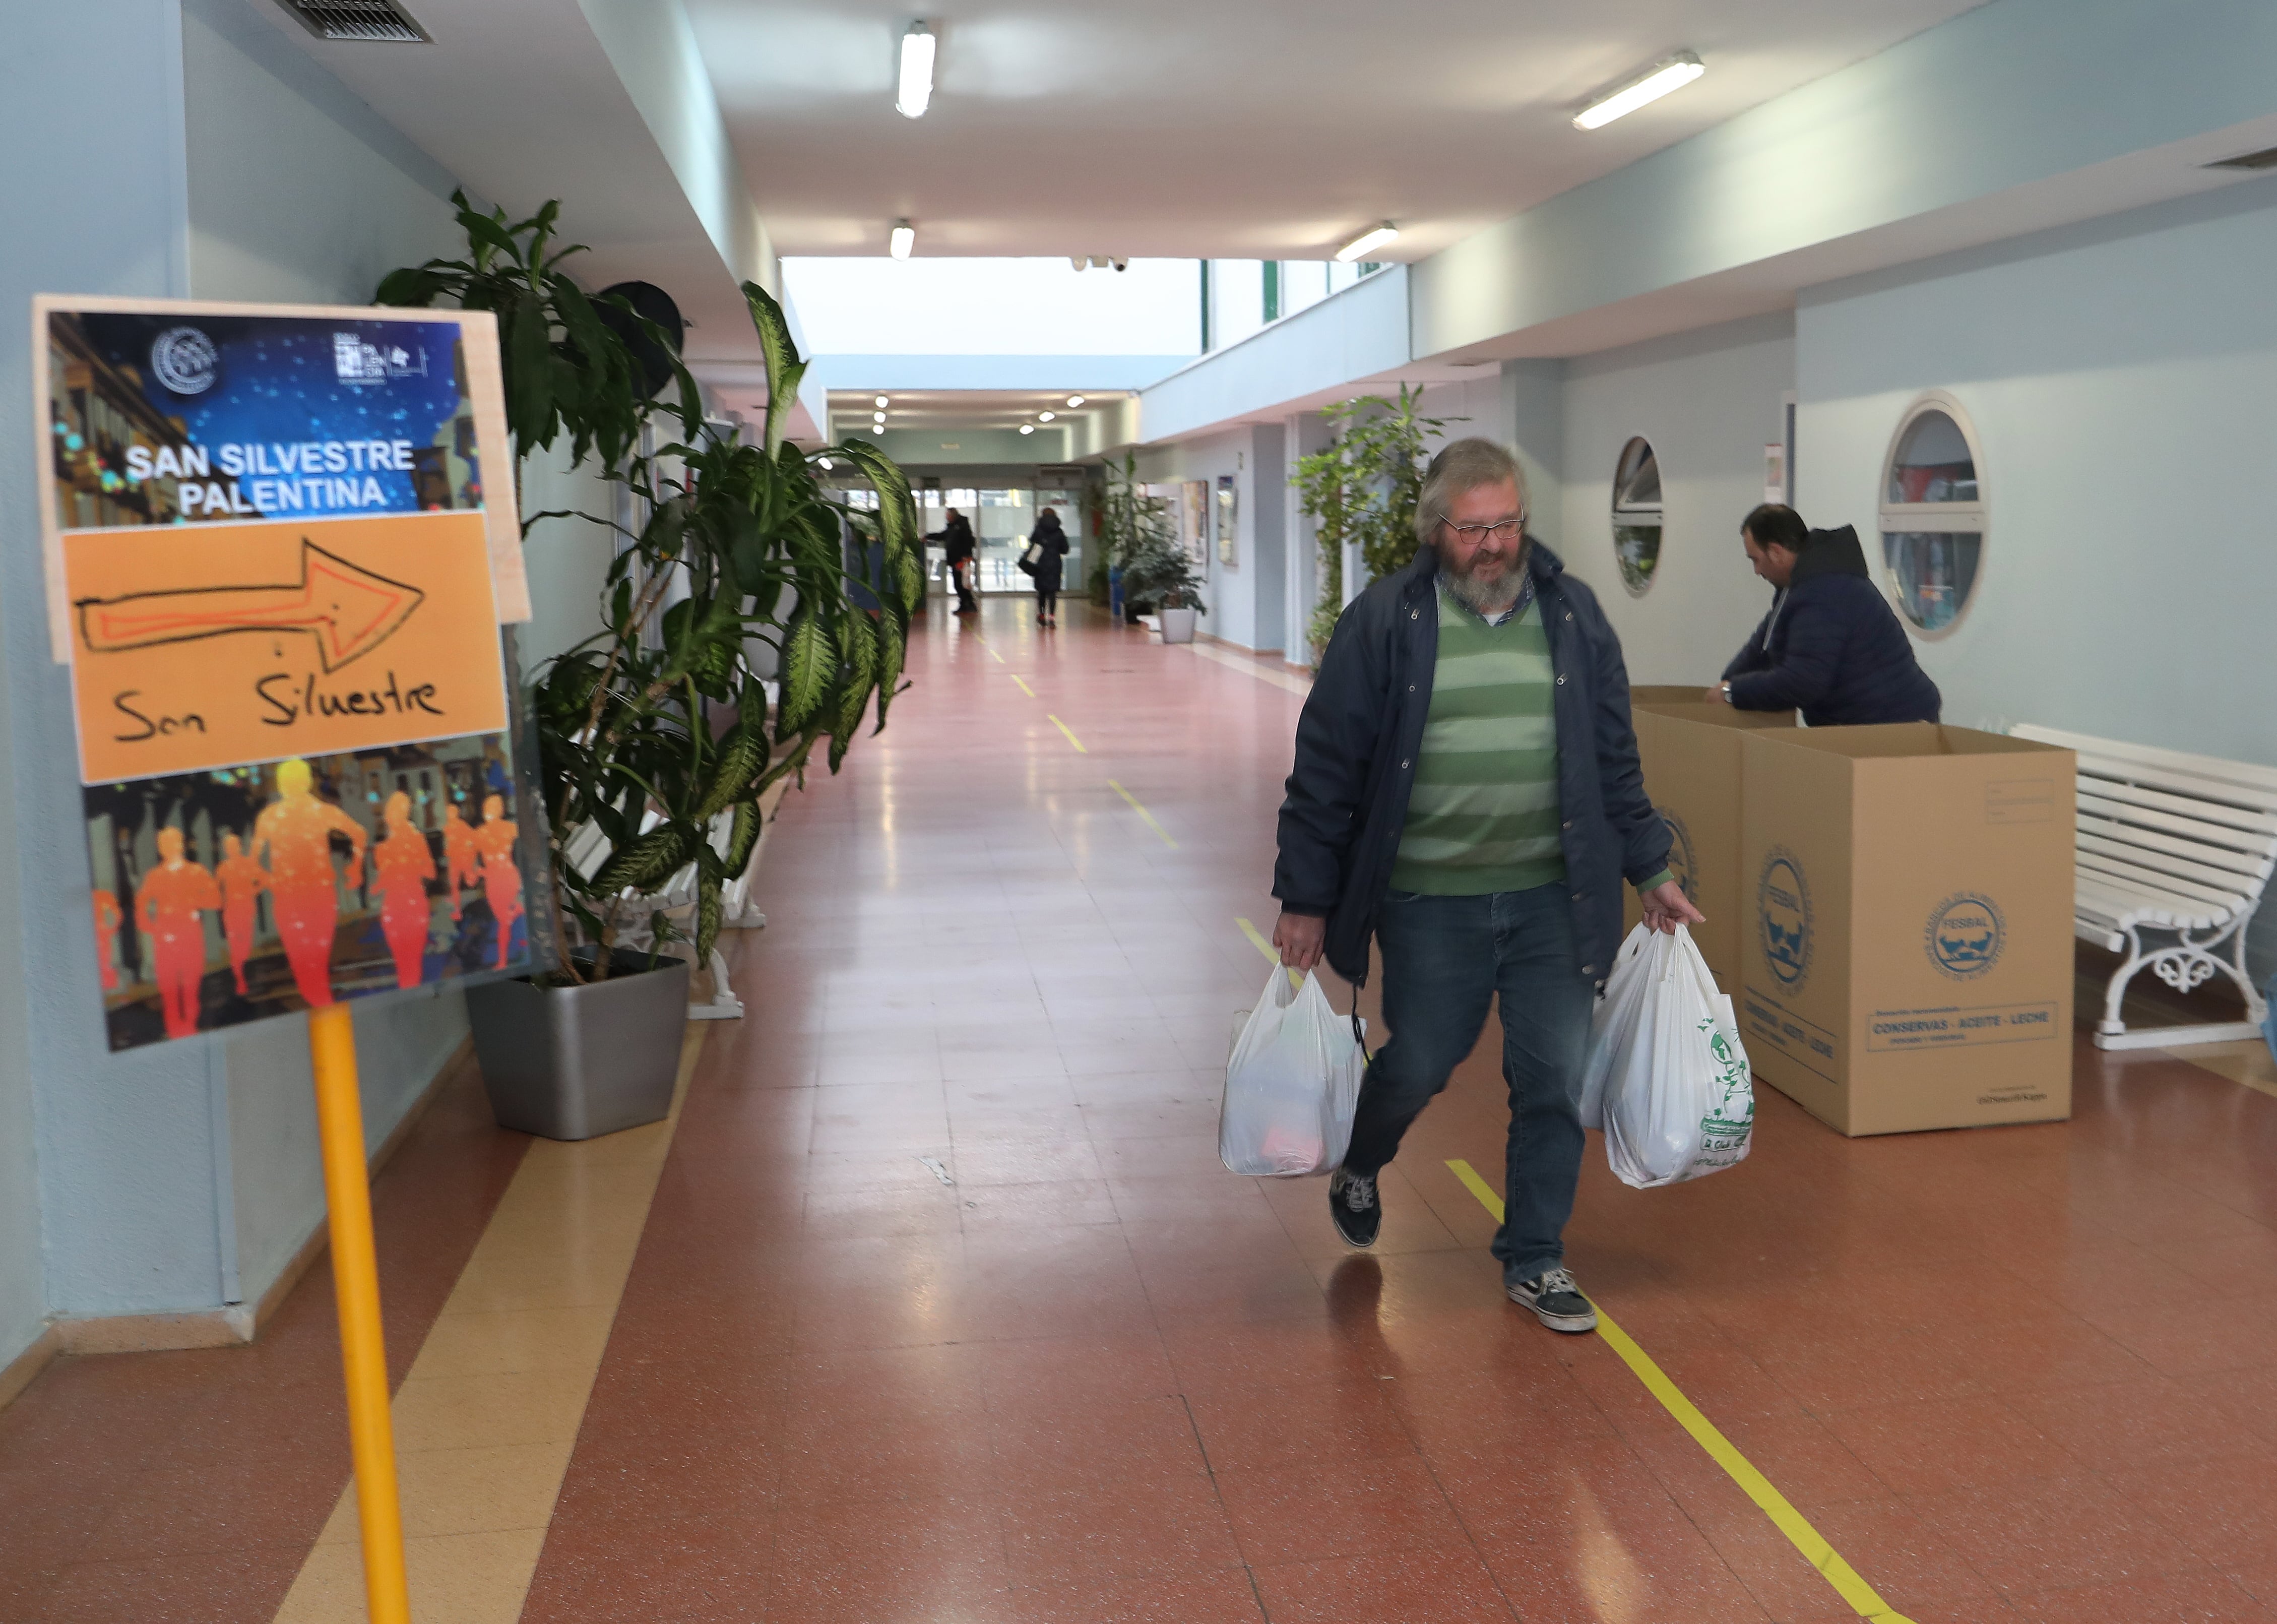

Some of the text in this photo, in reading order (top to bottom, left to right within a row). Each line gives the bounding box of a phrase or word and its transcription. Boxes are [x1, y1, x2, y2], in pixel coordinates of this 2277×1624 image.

[125, 440, 416, 480] SAN SILVESTRE
[178, 475, 388, 516] PALENTINA
[1943, 917, 1989, 929] FESBAL
[1873, 1010, 2049, 1034] CONSERVAS ACEITE LECHE
